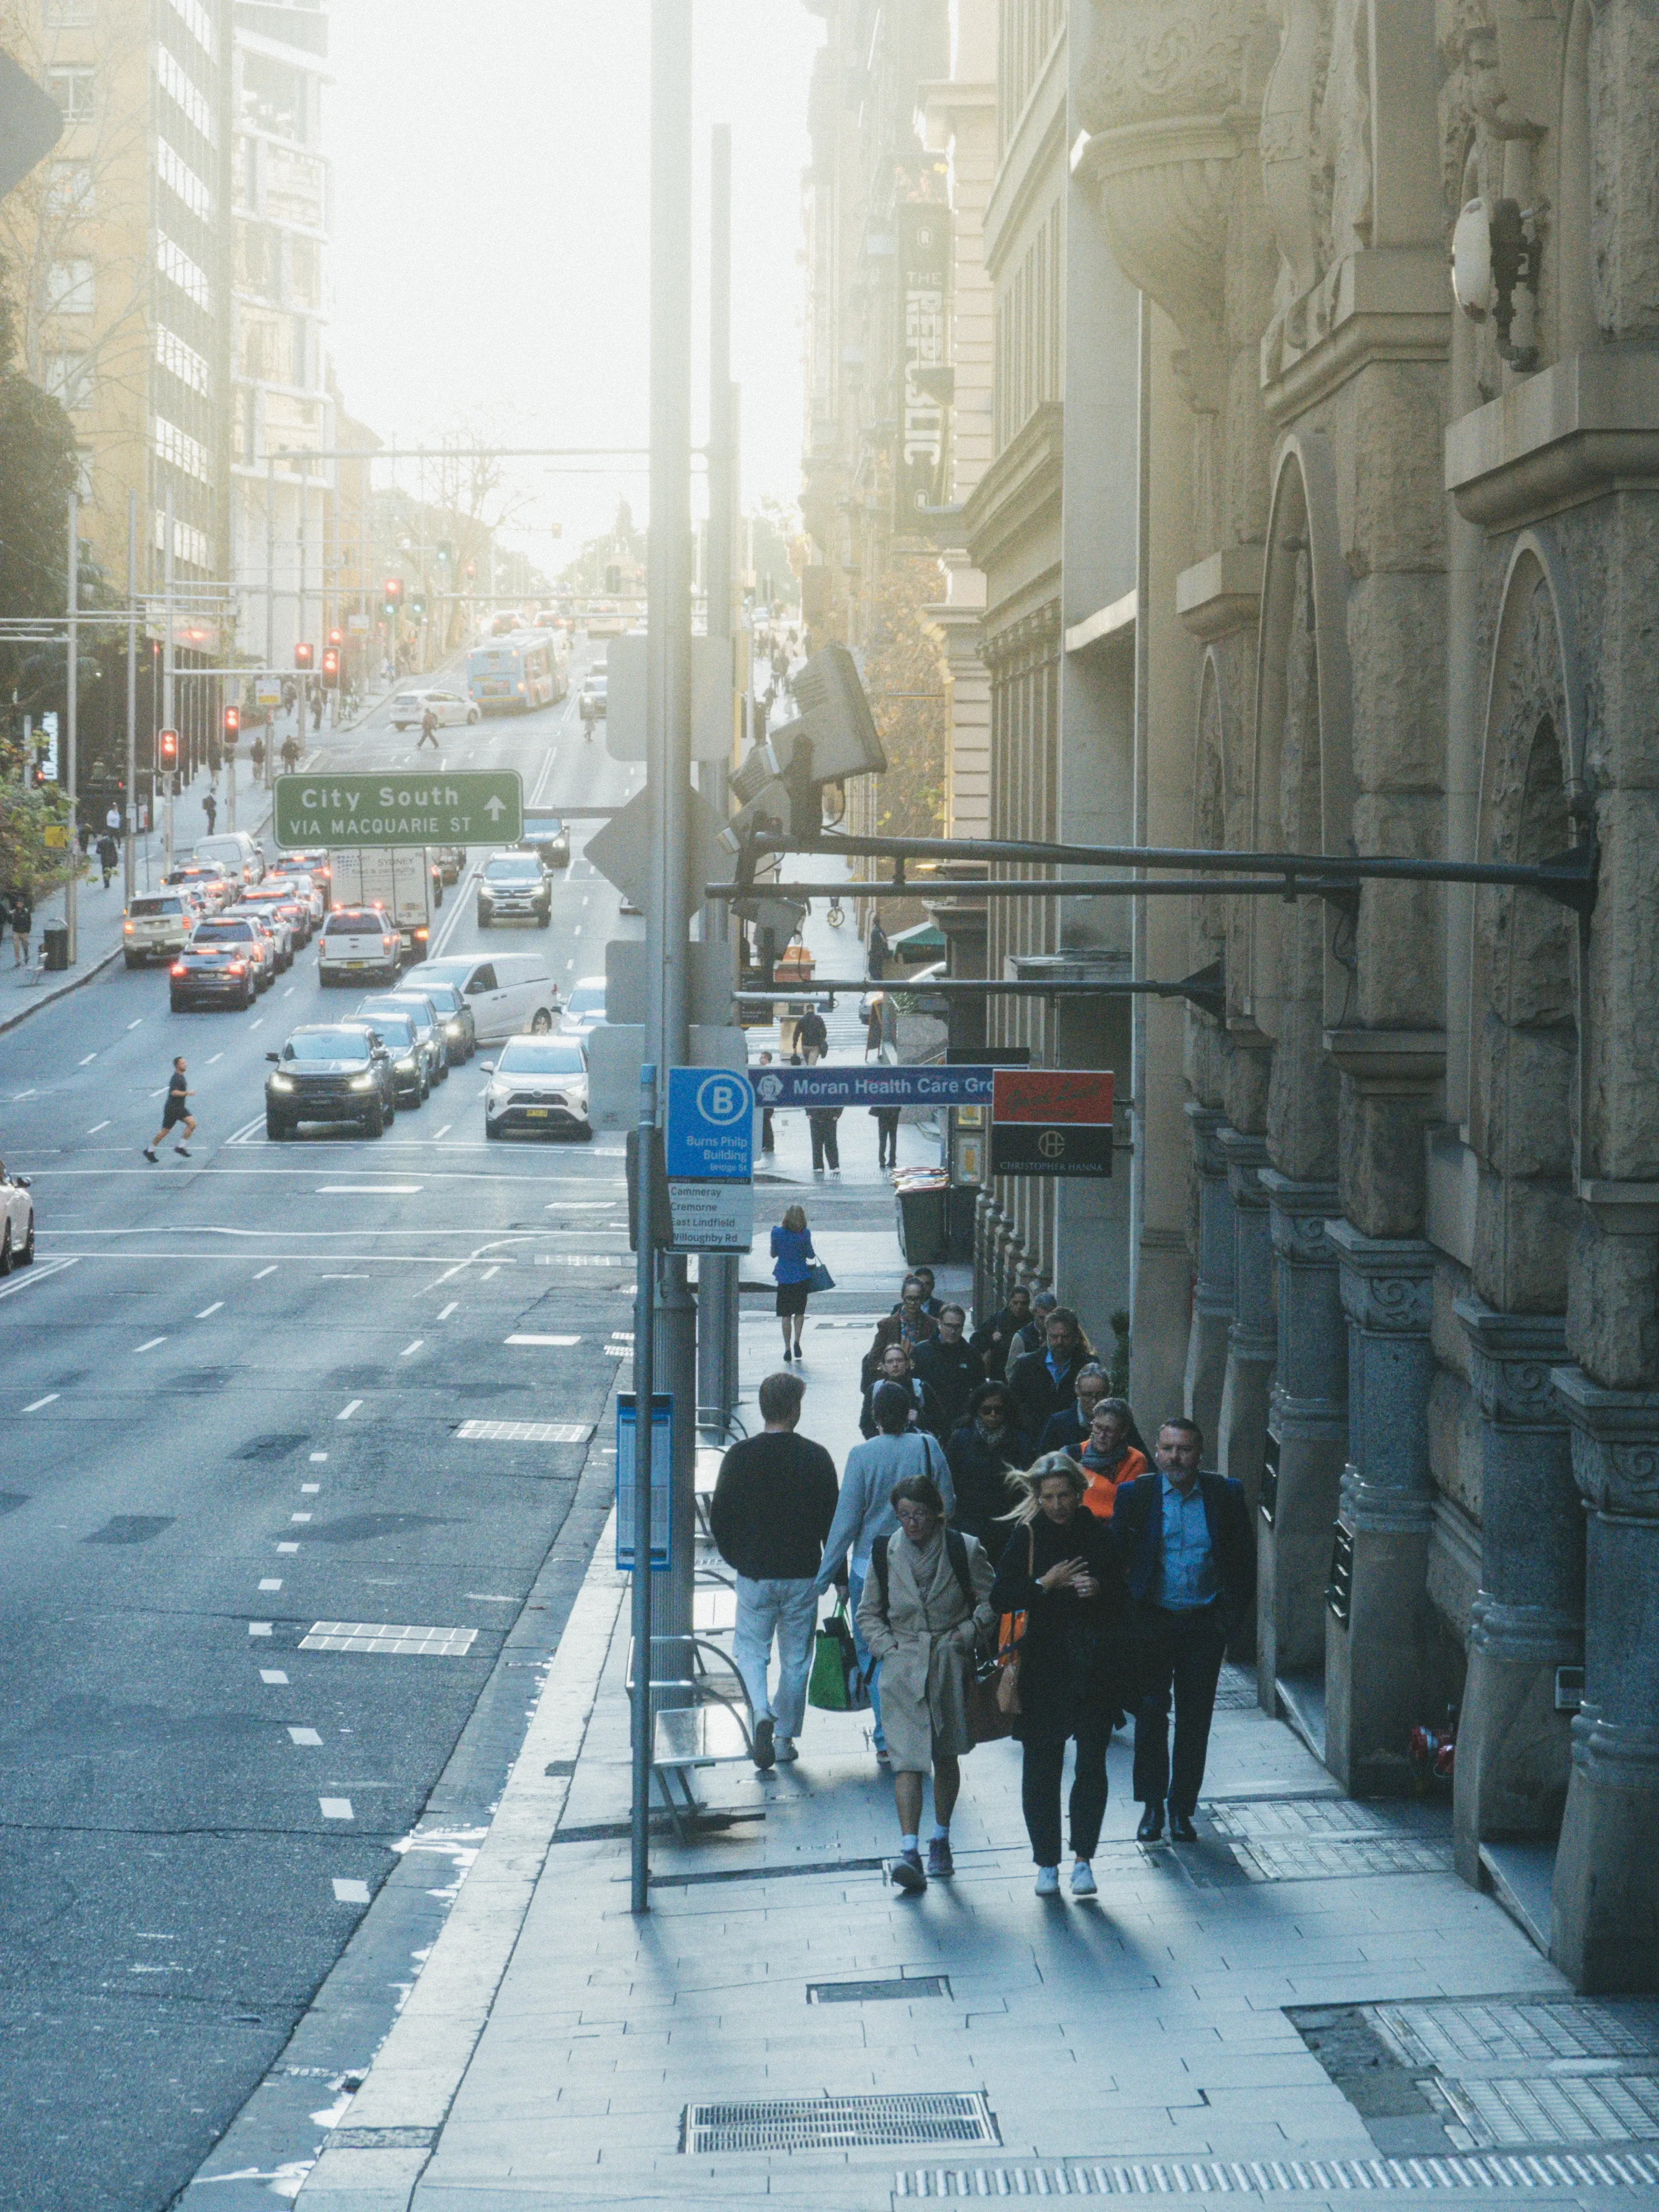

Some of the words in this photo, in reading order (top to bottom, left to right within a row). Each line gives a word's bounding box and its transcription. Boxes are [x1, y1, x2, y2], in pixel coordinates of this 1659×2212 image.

[907, 272, 942, 285] THE
[301, 789, 361, 811] City
[379, 786, 459, 807] South
[289, 820, 321, 835] VIA
[332, 818, 440, 834] MACQUARIE
[450, 816, 472, 832] ST
[378, 858, 414, 867] SYDNEY
[793, 1079, 849, 1095] Moran
[855, 1078, 911, 1094] Health
[917, 1077, 959, 1093] Care
[713, 1086, 734, 1114] B
[686, 1135, 719, 1146] Burns
[721, 1136, 747, 1149] Philp
[703, 1149, 747, 1162] Building
[709, 1163, 737, 1173] Bridge
[738, 1164, 747, 1172] St
[1000, 1161, 1065, 1171] CHRISTOPHER
[1068, 1162, 1103, 1171] HANNA
[671, 1187, 722, 1198] Cammeray
[671, 1202, 717, 1212] Cremorne
[671, 1218, 691, 1226] East
[692, 1218, 735, 1227] Lindfield
[725, 1234, 738, 1242] Rd
